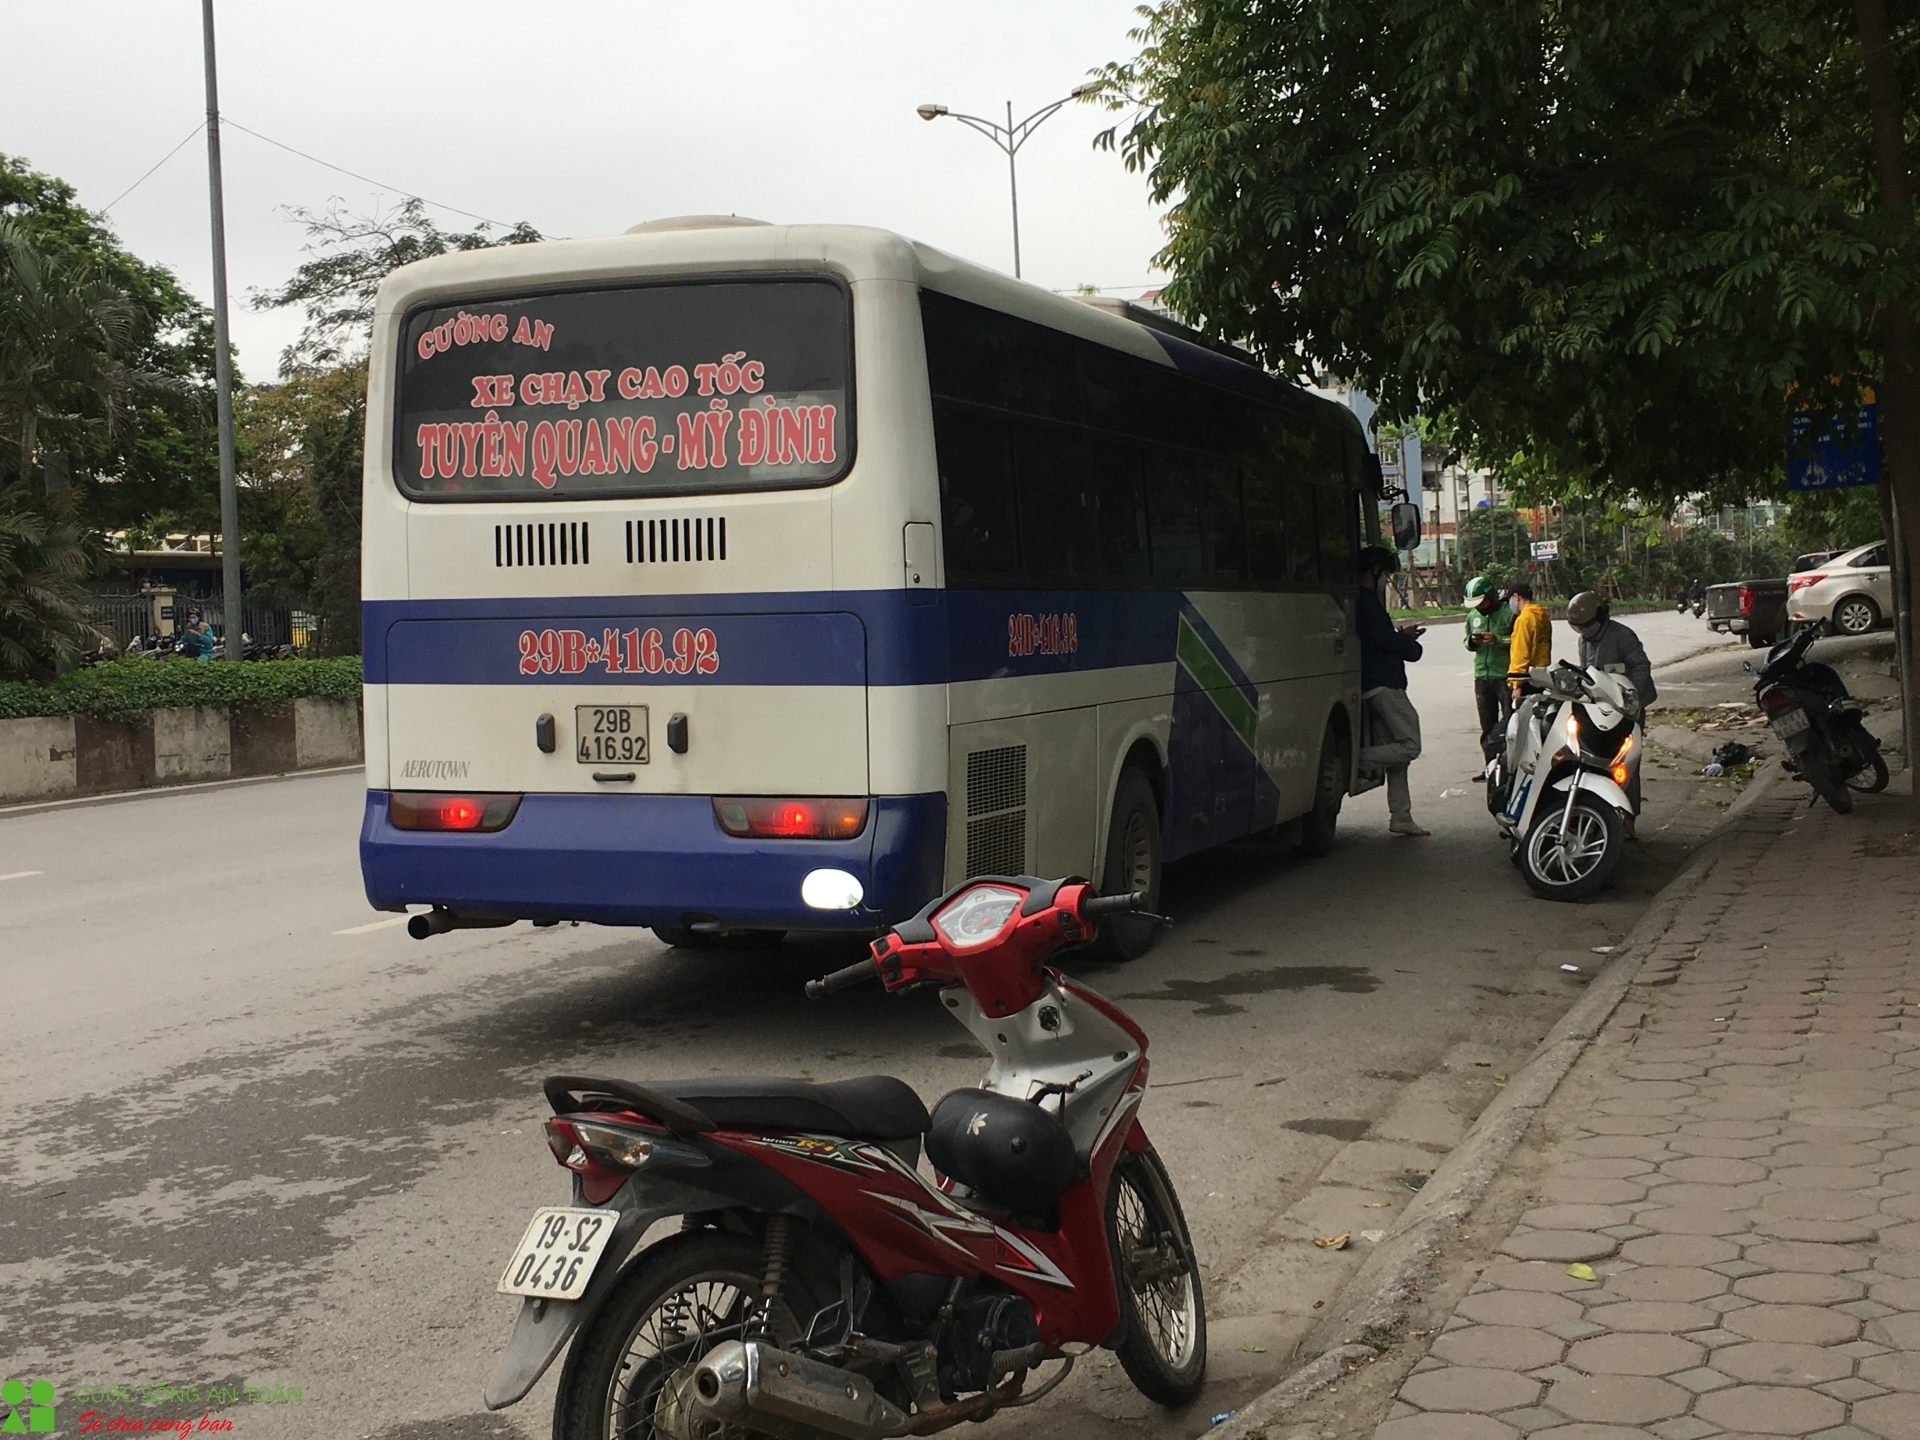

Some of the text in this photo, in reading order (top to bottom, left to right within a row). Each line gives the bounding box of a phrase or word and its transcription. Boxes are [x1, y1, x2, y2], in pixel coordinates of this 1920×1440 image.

[418, 310, 554, 360] CƯỜNG AN
[470, 351, 765, 410] XE CHẠY CAO TỐC
[417, 409, 528, 479] TUYÊN
[531, 415, 657, 489] QUANG
[677, 399, 734, 471] MỸ
[737, 395, 837, 466] ĐÌNH
[593, 708, 632, 734] 29B
[579, 736, 647, 761] 416.92
[536, 1214, 603, 1252] 19-S2
[513, 1253, 584, 1291] 0436
